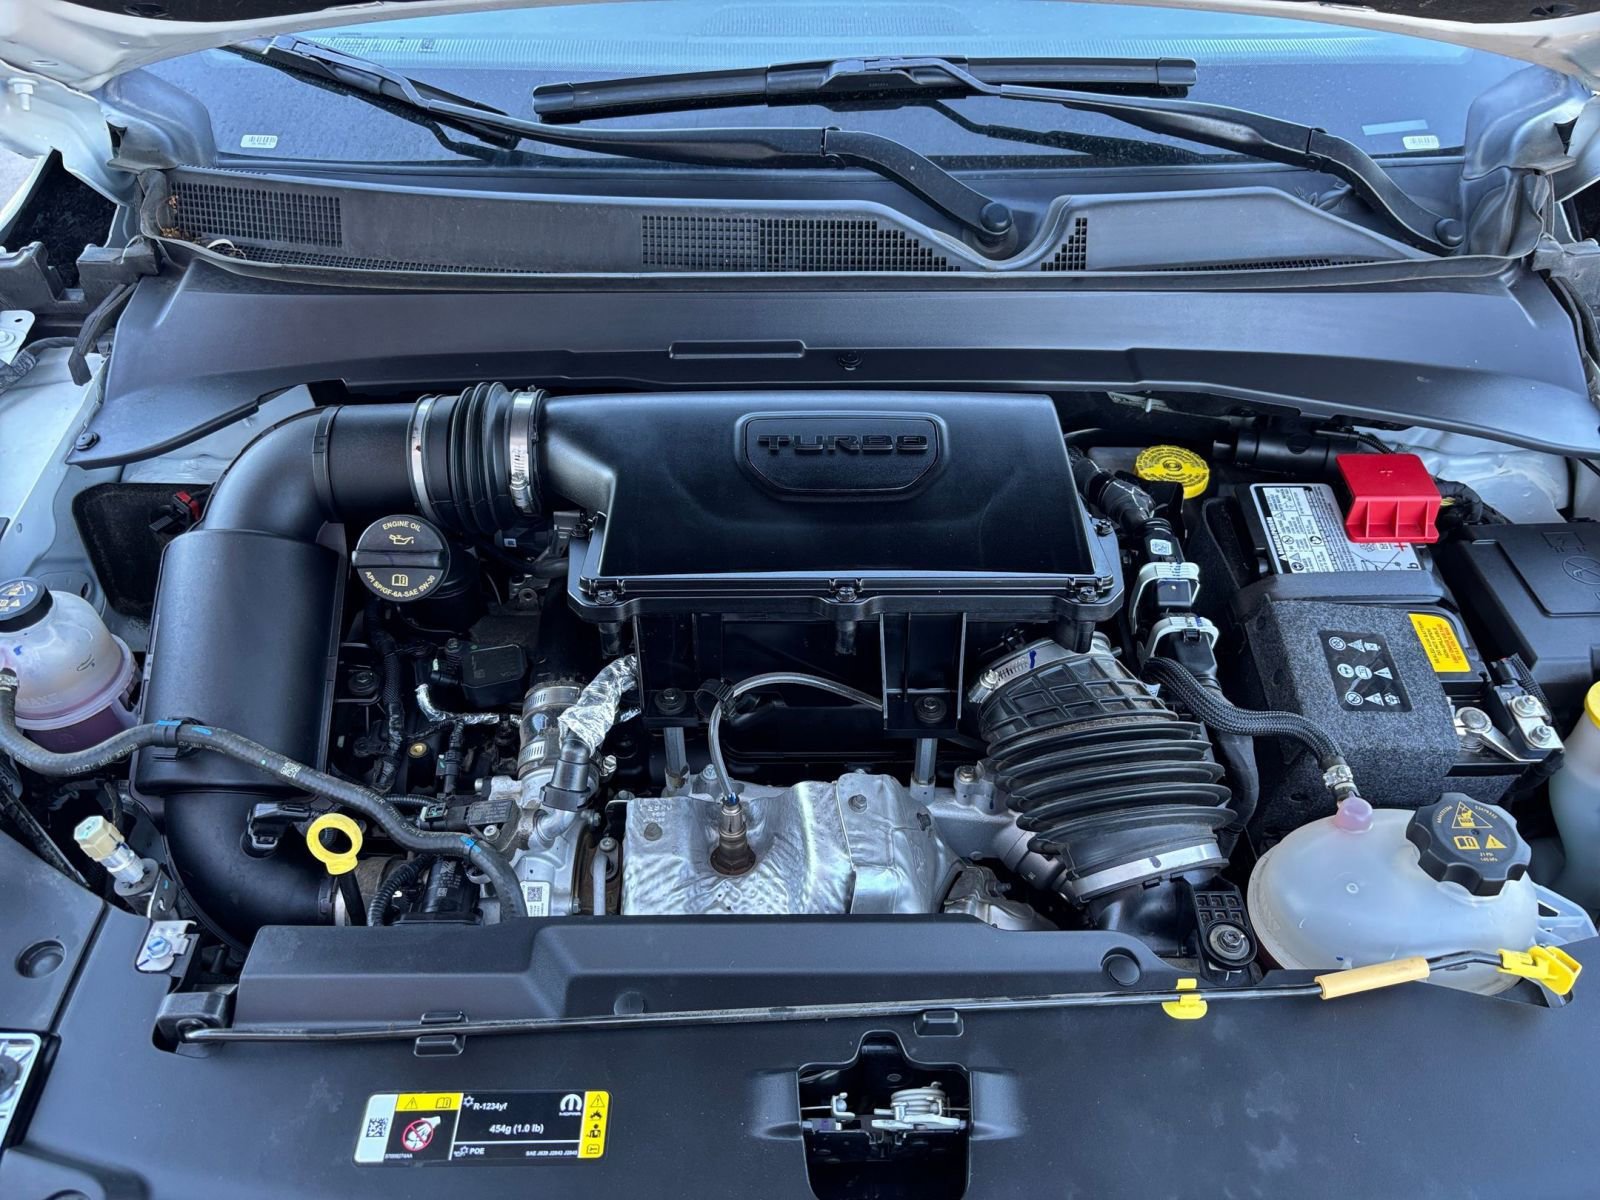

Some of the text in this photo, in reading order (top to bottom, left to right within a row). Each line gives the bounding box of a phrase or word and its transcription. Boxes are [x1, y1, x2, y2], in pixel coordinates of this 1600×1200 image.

[382, 520, 421, 532] ENGINE OIL
[364, 571, 374, 583] API
[419, 574, 436, 592] 5W-30
[354, 785, 386, 805] HEATER
[473, 1102, 508, 1111] R-1234yf
[489, 1124, 544, 1135] 454g (1.0 lb)
